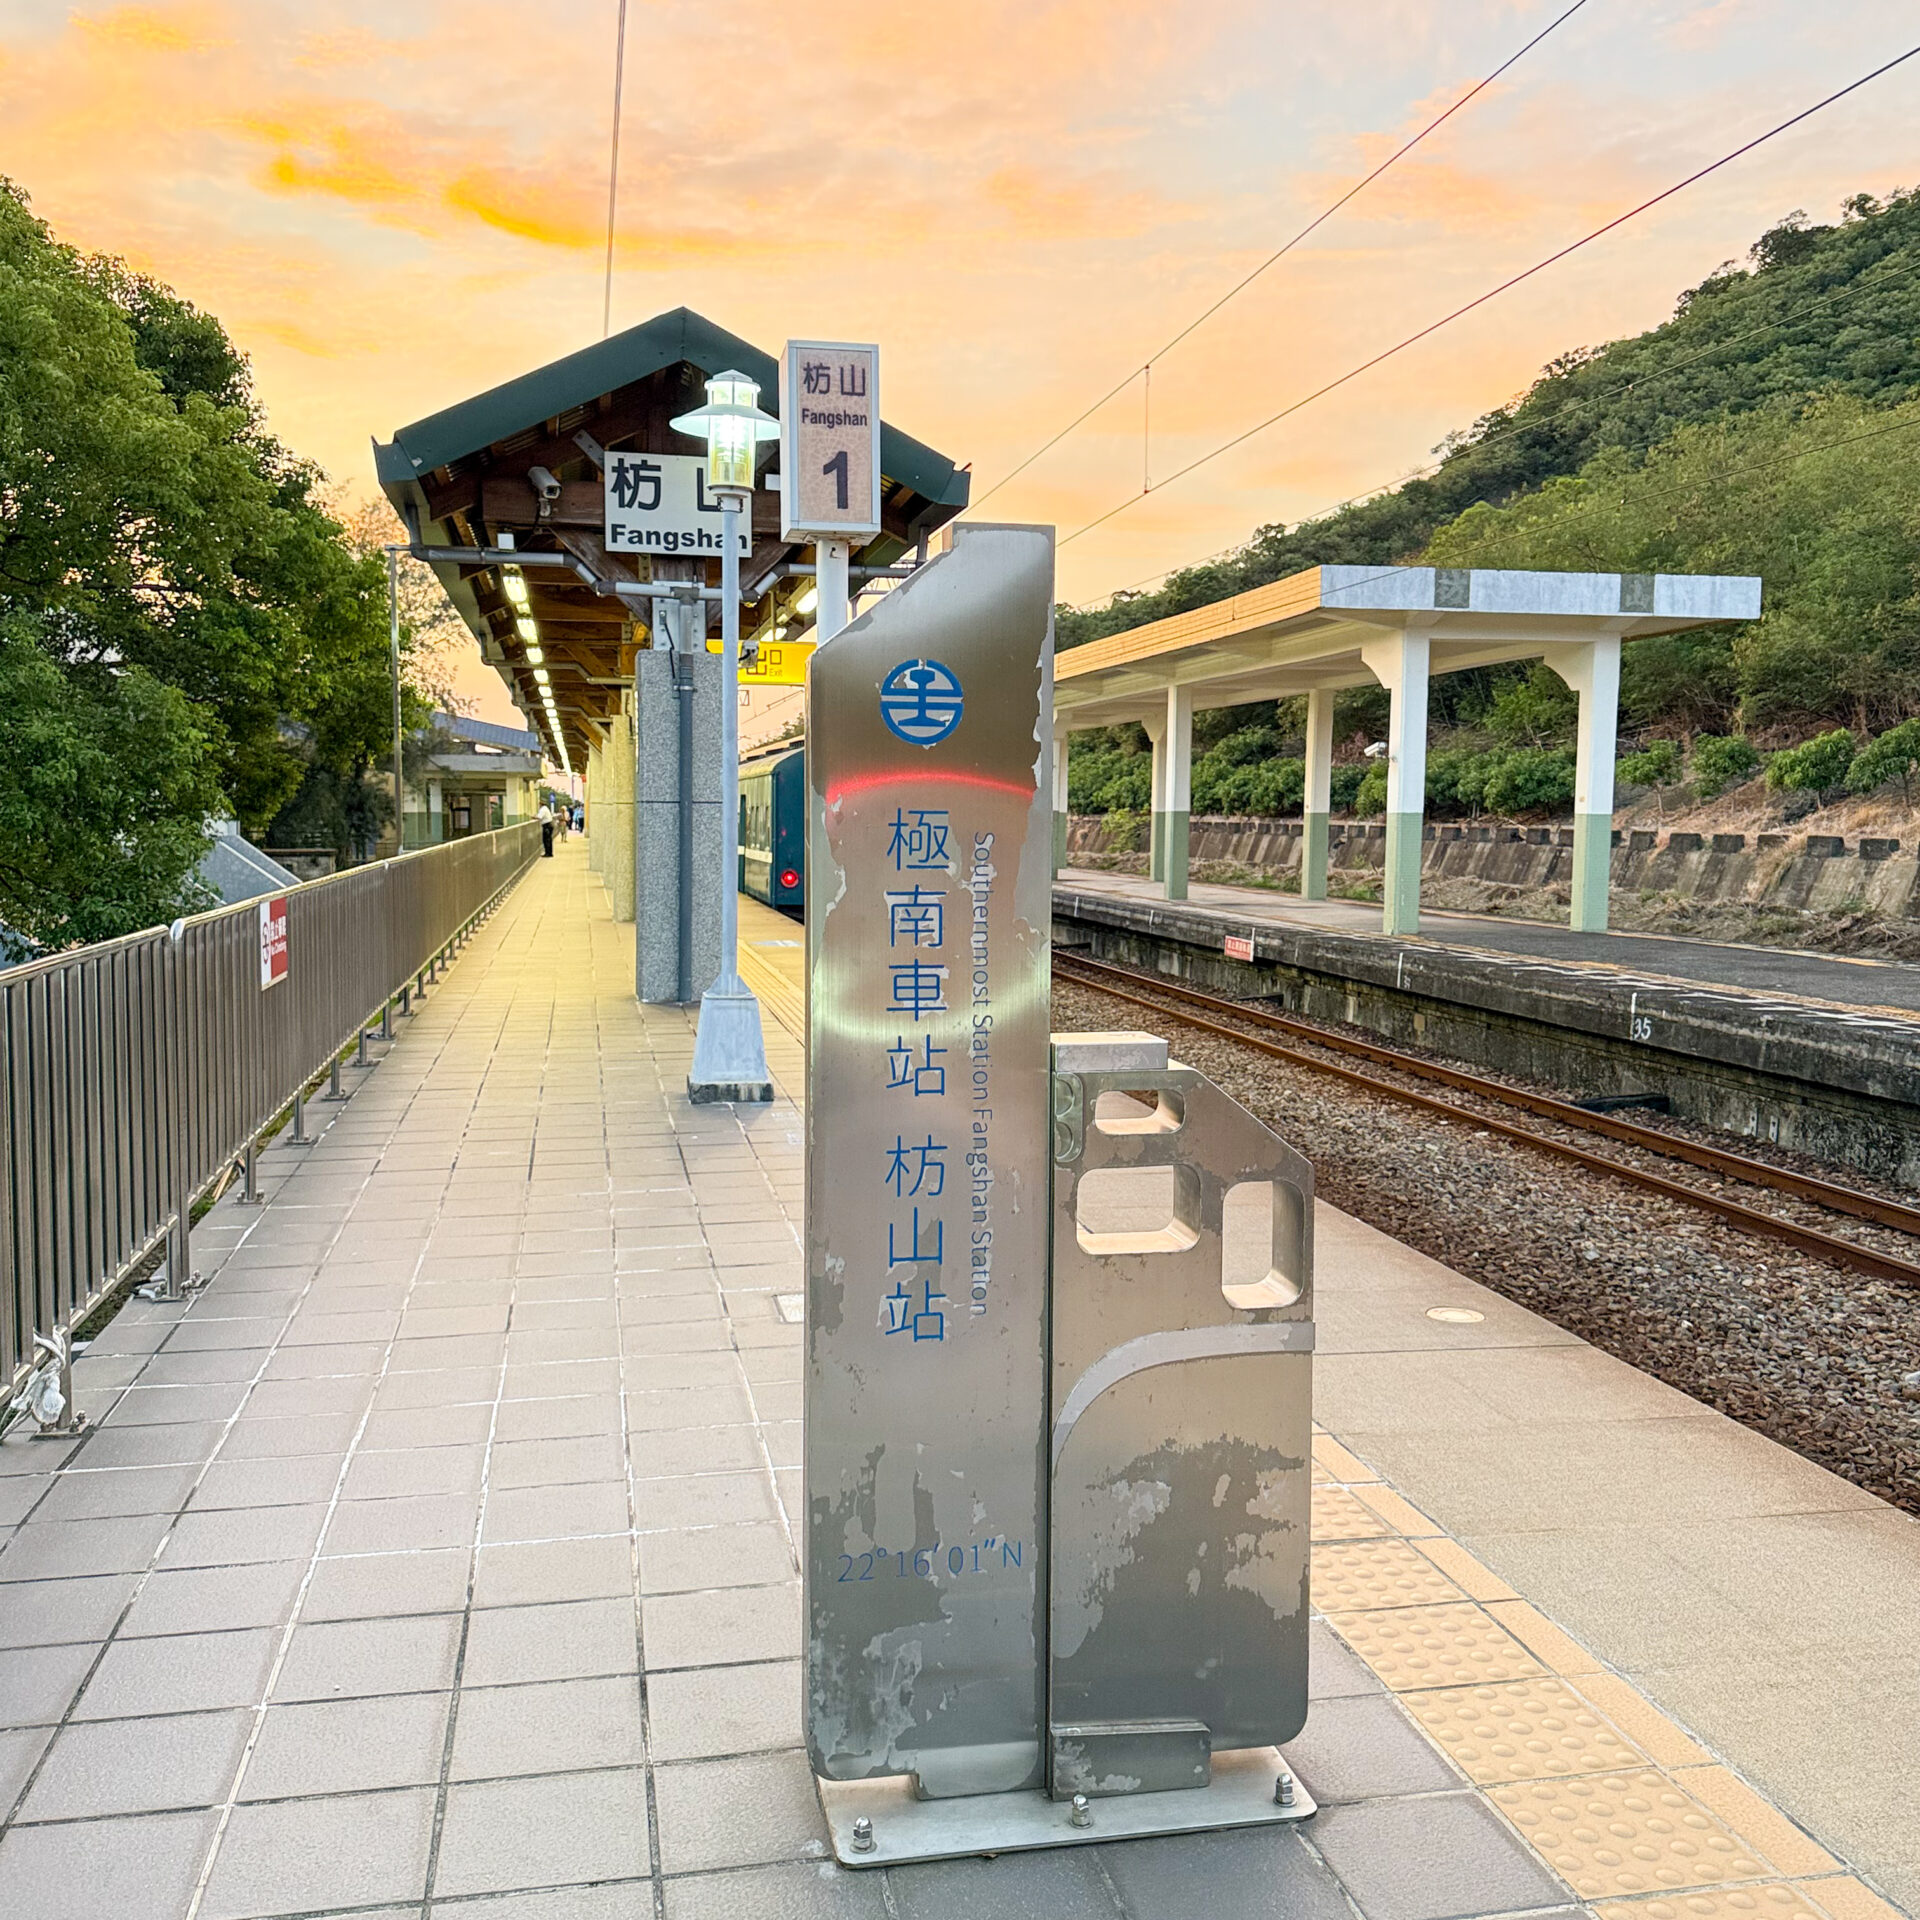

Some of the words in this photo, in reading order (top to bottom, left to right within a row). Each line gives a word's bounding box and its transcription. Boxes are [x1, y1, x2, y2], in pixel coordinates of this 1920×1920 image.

[802, 408, 868, 429] Fangshan
[803, 361, 866, 397] 枋山
[823, 451, 849, 509] 1
[886, 807, 949, 1096] 極南車站
[972, 831, 995, 1007] Southernmost
[972, 1014, 993, 1100] Station
[966, 1108, 993, 1223] Fangshan
[885, 1134, 948, 1343] 枋山站
[971, 1231, 992, 1316] Station
